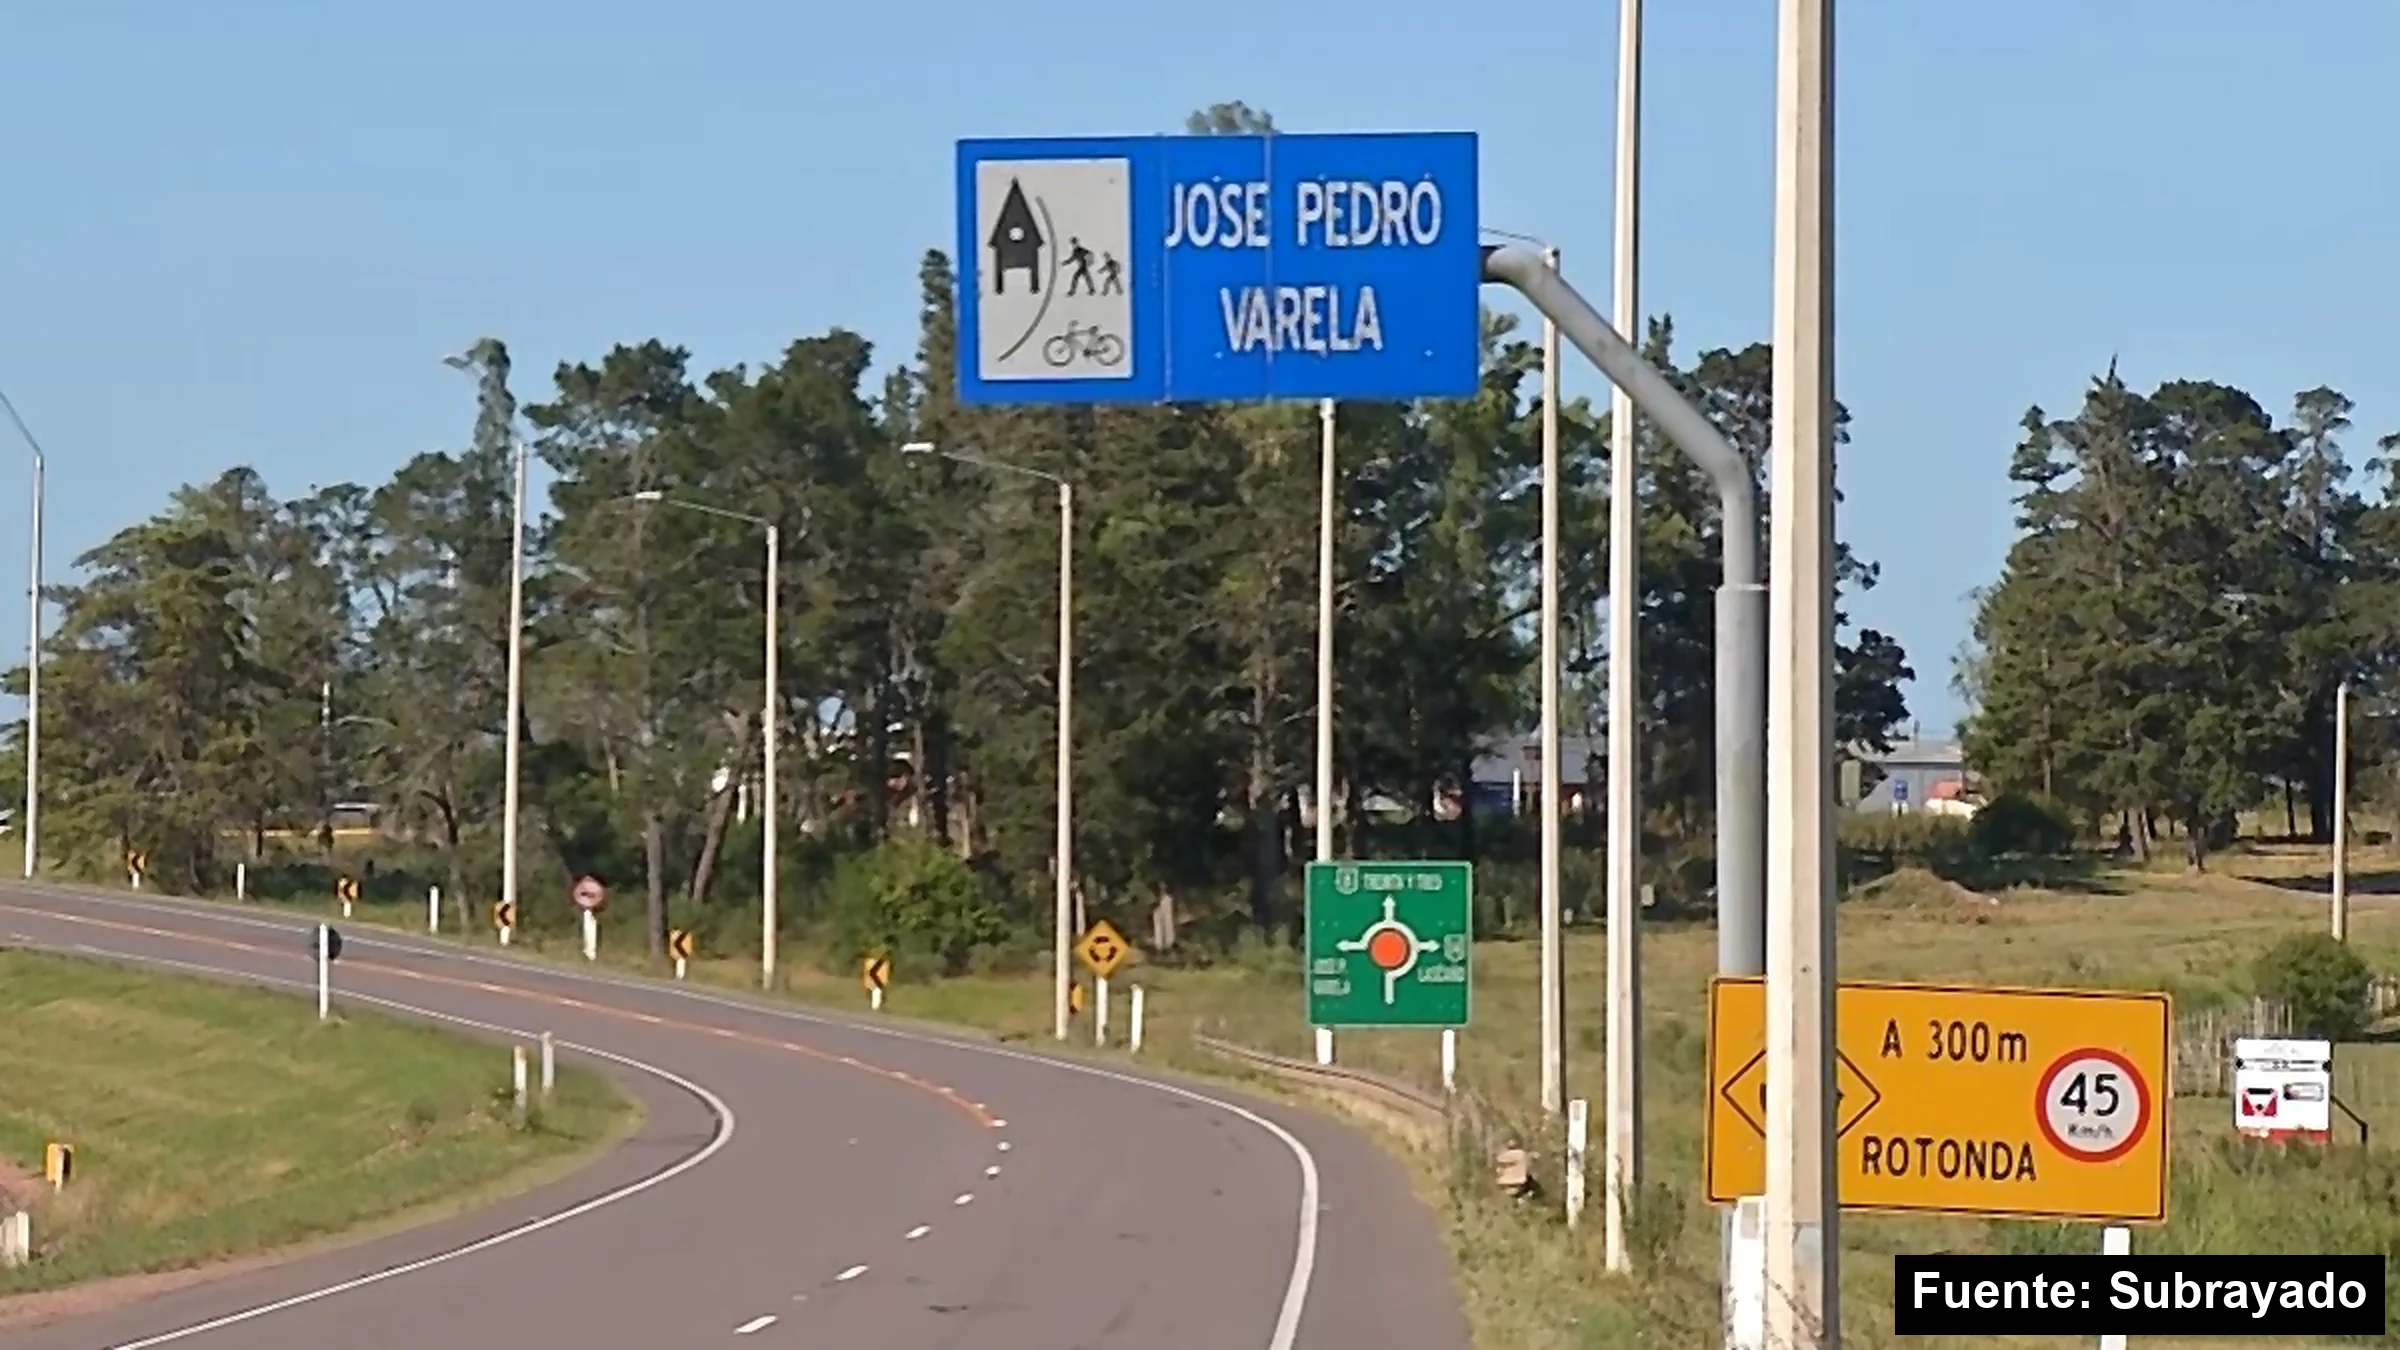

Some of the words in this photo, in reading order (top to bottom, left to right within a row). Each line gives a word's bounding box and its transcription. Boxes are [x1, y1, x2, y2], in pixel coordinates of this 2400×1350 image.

[1165, 181, 1269, 248] JOSE
[1297, 180, 1442, 247] PEDRO
[1220, 285, 1383, 353] VARELA
[1881, 1018, 1903, 1059] A
[2060, 1071, 2119, 1116] 45
[1862, 1135, 2037, 1181] ROTONDA
